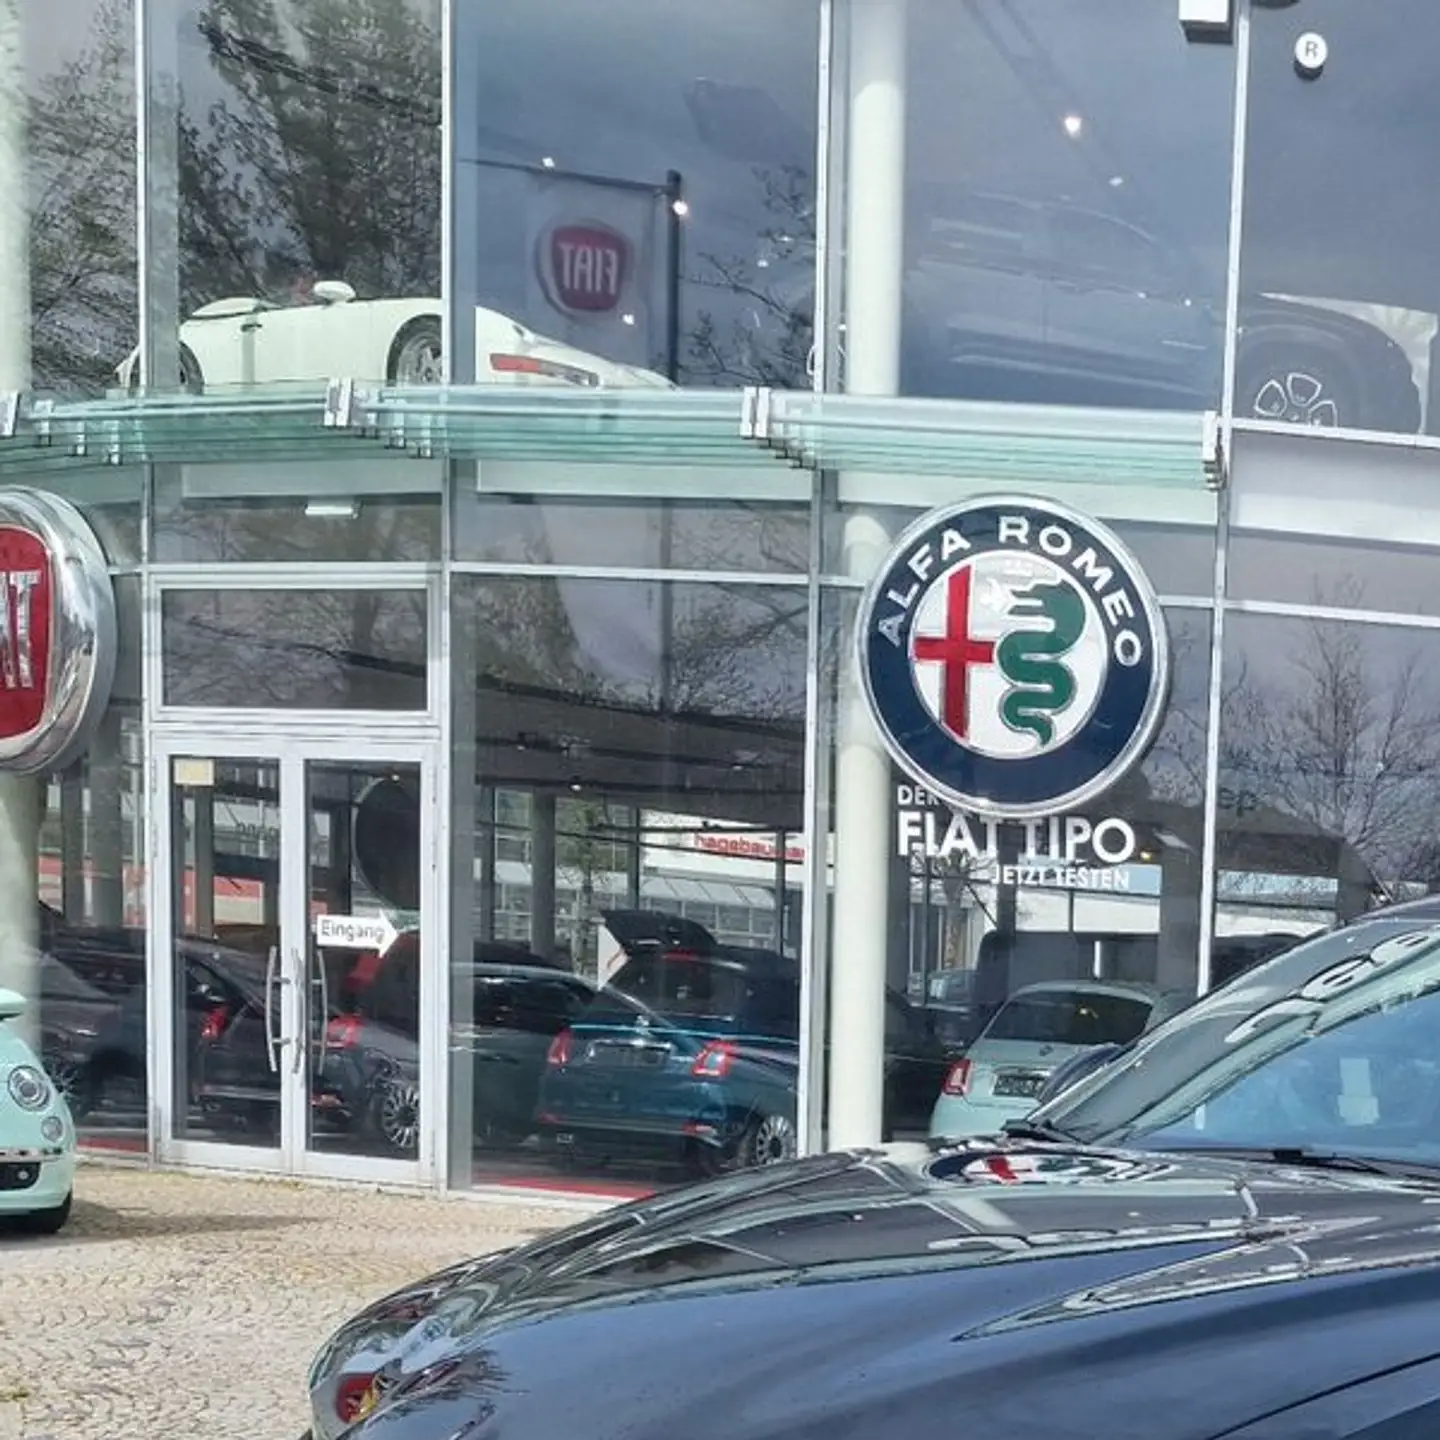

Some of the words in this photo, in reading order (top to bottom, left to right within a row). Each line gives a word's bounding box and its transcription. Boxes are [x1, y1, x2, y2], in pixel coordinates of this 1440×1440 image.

[878, 528, 972, 647] ALFA
[998, 515, 1142, 667] ROMEO
[897, 784, 941, 806] DER
[898, 810, 1001, 859] FIAT
[1019, 815, 1136, 864] TIPO
[990, 864, 1047, 887] JETZT
[1054, 866, 1130, 891] TESTEN
[321, 918, 385, 945] Eingang
